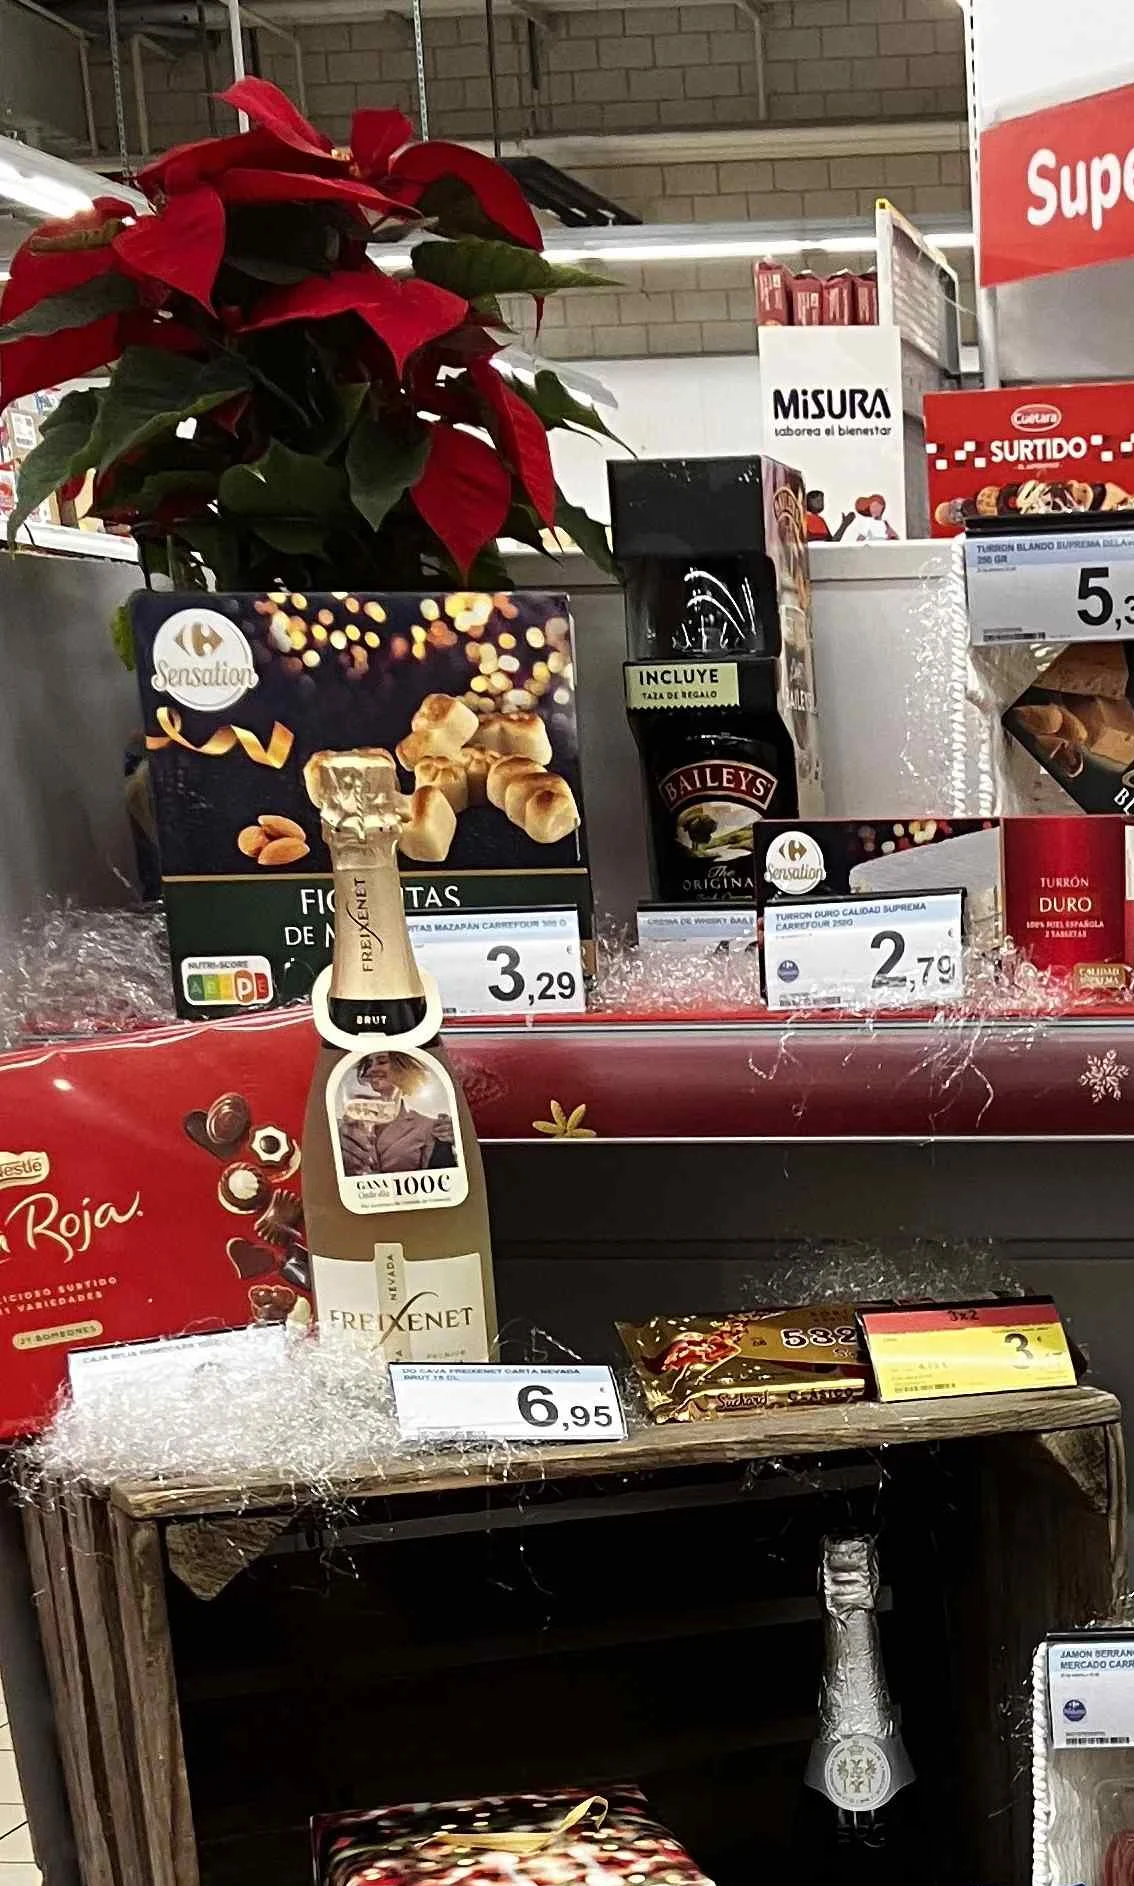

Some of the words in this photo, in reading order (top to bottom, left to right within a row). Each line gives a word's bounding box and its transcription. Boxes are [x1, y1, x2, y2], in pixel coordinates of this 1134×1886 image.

[774, 425, 821, 437] saborea
[824, 424, 835, 436] el
[838, 424, 892, 437] bienestar
[990, 435, 1088, 463] SURTIDO
[1016, 542, 1056, 552] BLANDO
[1056, 540, 1101, 550] SUPREMA
[155, 659, 258, 690] Sensation
[638, 668, 720, 686] INCLUYE
[642, 691, 665, 700] TAZA
[666, 691, 680, 700] DE
[681, 689, 718, 699] REGALO
[665, 767, 767, 802] BAILEYS
[764, 862, 826, 882] Sensation
[682, 876, 755, 892] ORIGINA
[1040, 875, 1089, 888] TURRÓN
[775, 912, 813, 921] TURRON
[814, 909, 840, 919] DURO
[841, 906, 881, 917] CALIDAD
[883, 902, 927, 913] SUPREMA
[1039, 895, 1093, 913] DURO
[350, 877, 380, 972] FREIXENET
[481, 919, 540, 930] CARREFOUR
[775, 920, 830, 931] CARREFOUR
[284, 926, 315, 946] DE
[188, 960, 249, 970] NUTRI-SCORE
[870, 929, 956, 993] 2,79
[486, 944, 577, 1007] 3,29
[355, 1014, 388, 1026] BRUT
[355, 1178, 390, 1191] GANA
[58, 1276, 118, 1294] SURTIDO
[389, 1253, 398, 1303] NEVADA
[17, 1291, 104, 1313] VARIEDADES
[330, 1298, 473, 1339] FREIXENET
[947, 1308, 980, 1322] 3x2
[35, 1325, 98, 1342] BOMBONES
[517, 1384, 613, 1431] 6,95
[1060, 1649, 1093, 1659] JAMON
[1060, 1659, 1107, 1670] MERCADO
